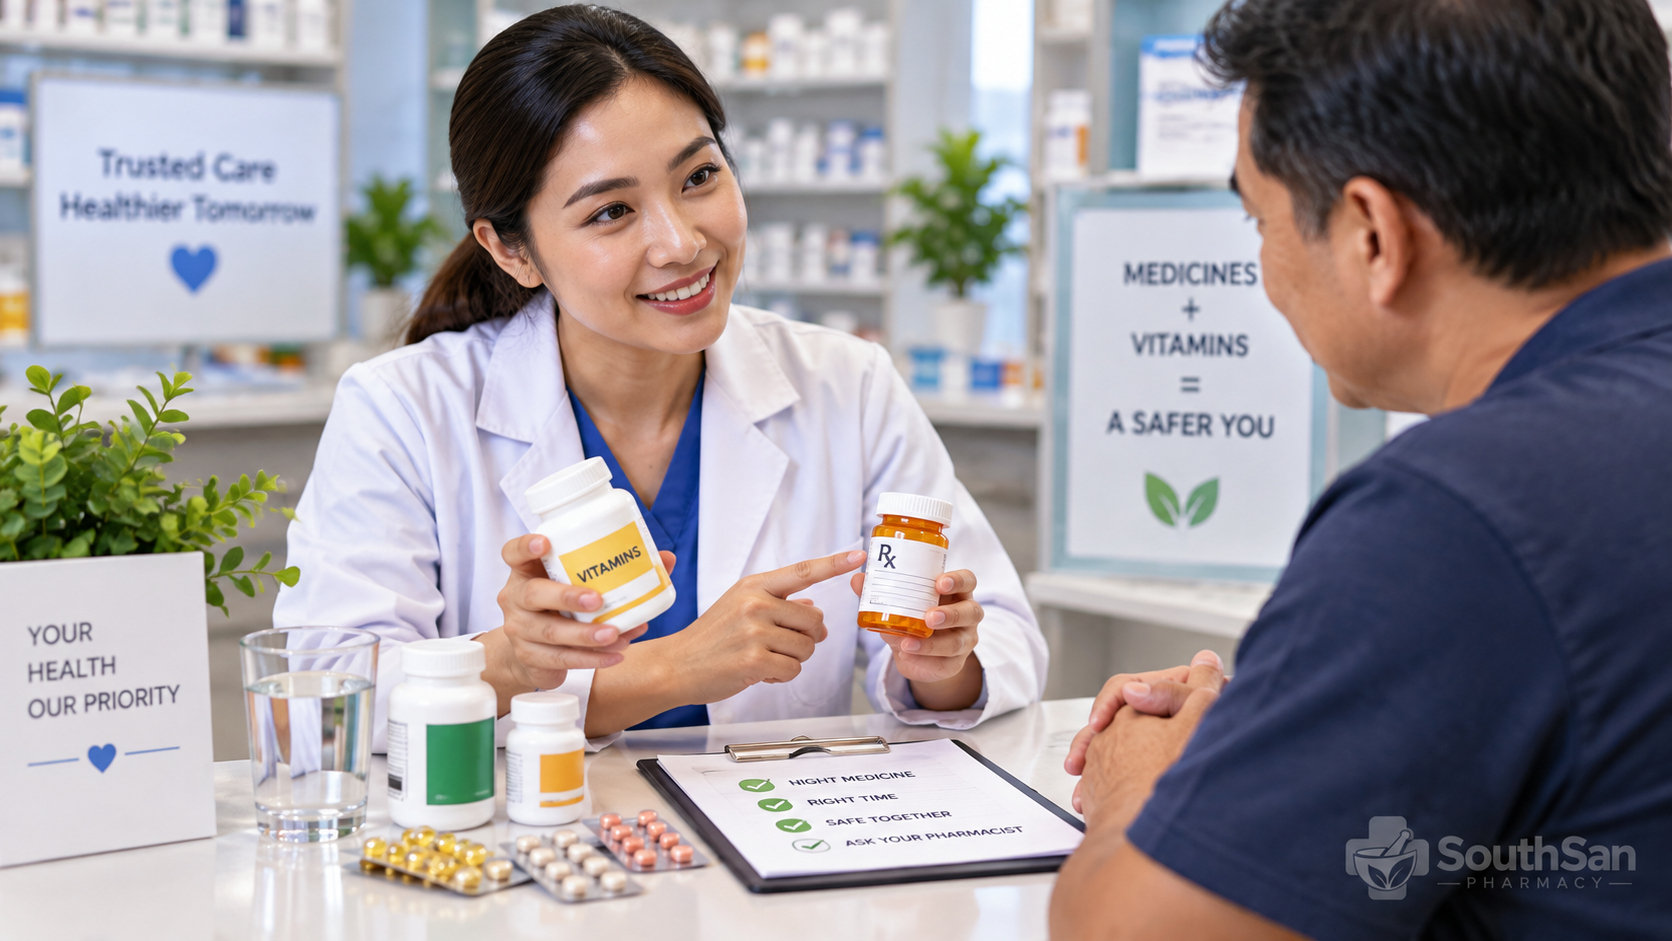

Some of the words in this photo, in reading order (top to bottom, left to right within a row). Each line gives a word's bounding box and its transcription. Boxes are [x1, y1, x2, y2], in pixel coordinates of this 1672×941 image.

[98, 149, 205, 183] Trusted
[212, 154, 277, 183] Care
[60, 193, 183, 221] Healthier
[193, 197, 317, 224] Tomorrow
[1124, 262, 1258, 287] MEDICINES
[1131, 333, 1249, 357] VITAMINS
[1106, 411, 1125, 435] A
[1132, 412, 1213, 437] SAFER
[1220, 415, 1275, 438] YOU
[576, 545, 642, 583] VITAMINS
[27, 621, 93, 646] YOUR
[27, 656, 116, 683] HEALTH
[27, 695, 77, 720] OUR
[84, 684, 180, 713] PRIORITY
[841, 771, 917, 783] MEDICINE
[806, 796, 855, 807] RIGHT
[858, 793, 899, 803] TIME
[825, 817, 867, 828] SAFE
[868, 810, 952, 825] TOGETHER
[845, 838, 876, 848] ASK
[879, 834, 922, 845] YOUR
[925, 825, 1023, 841] PHARMACIST
